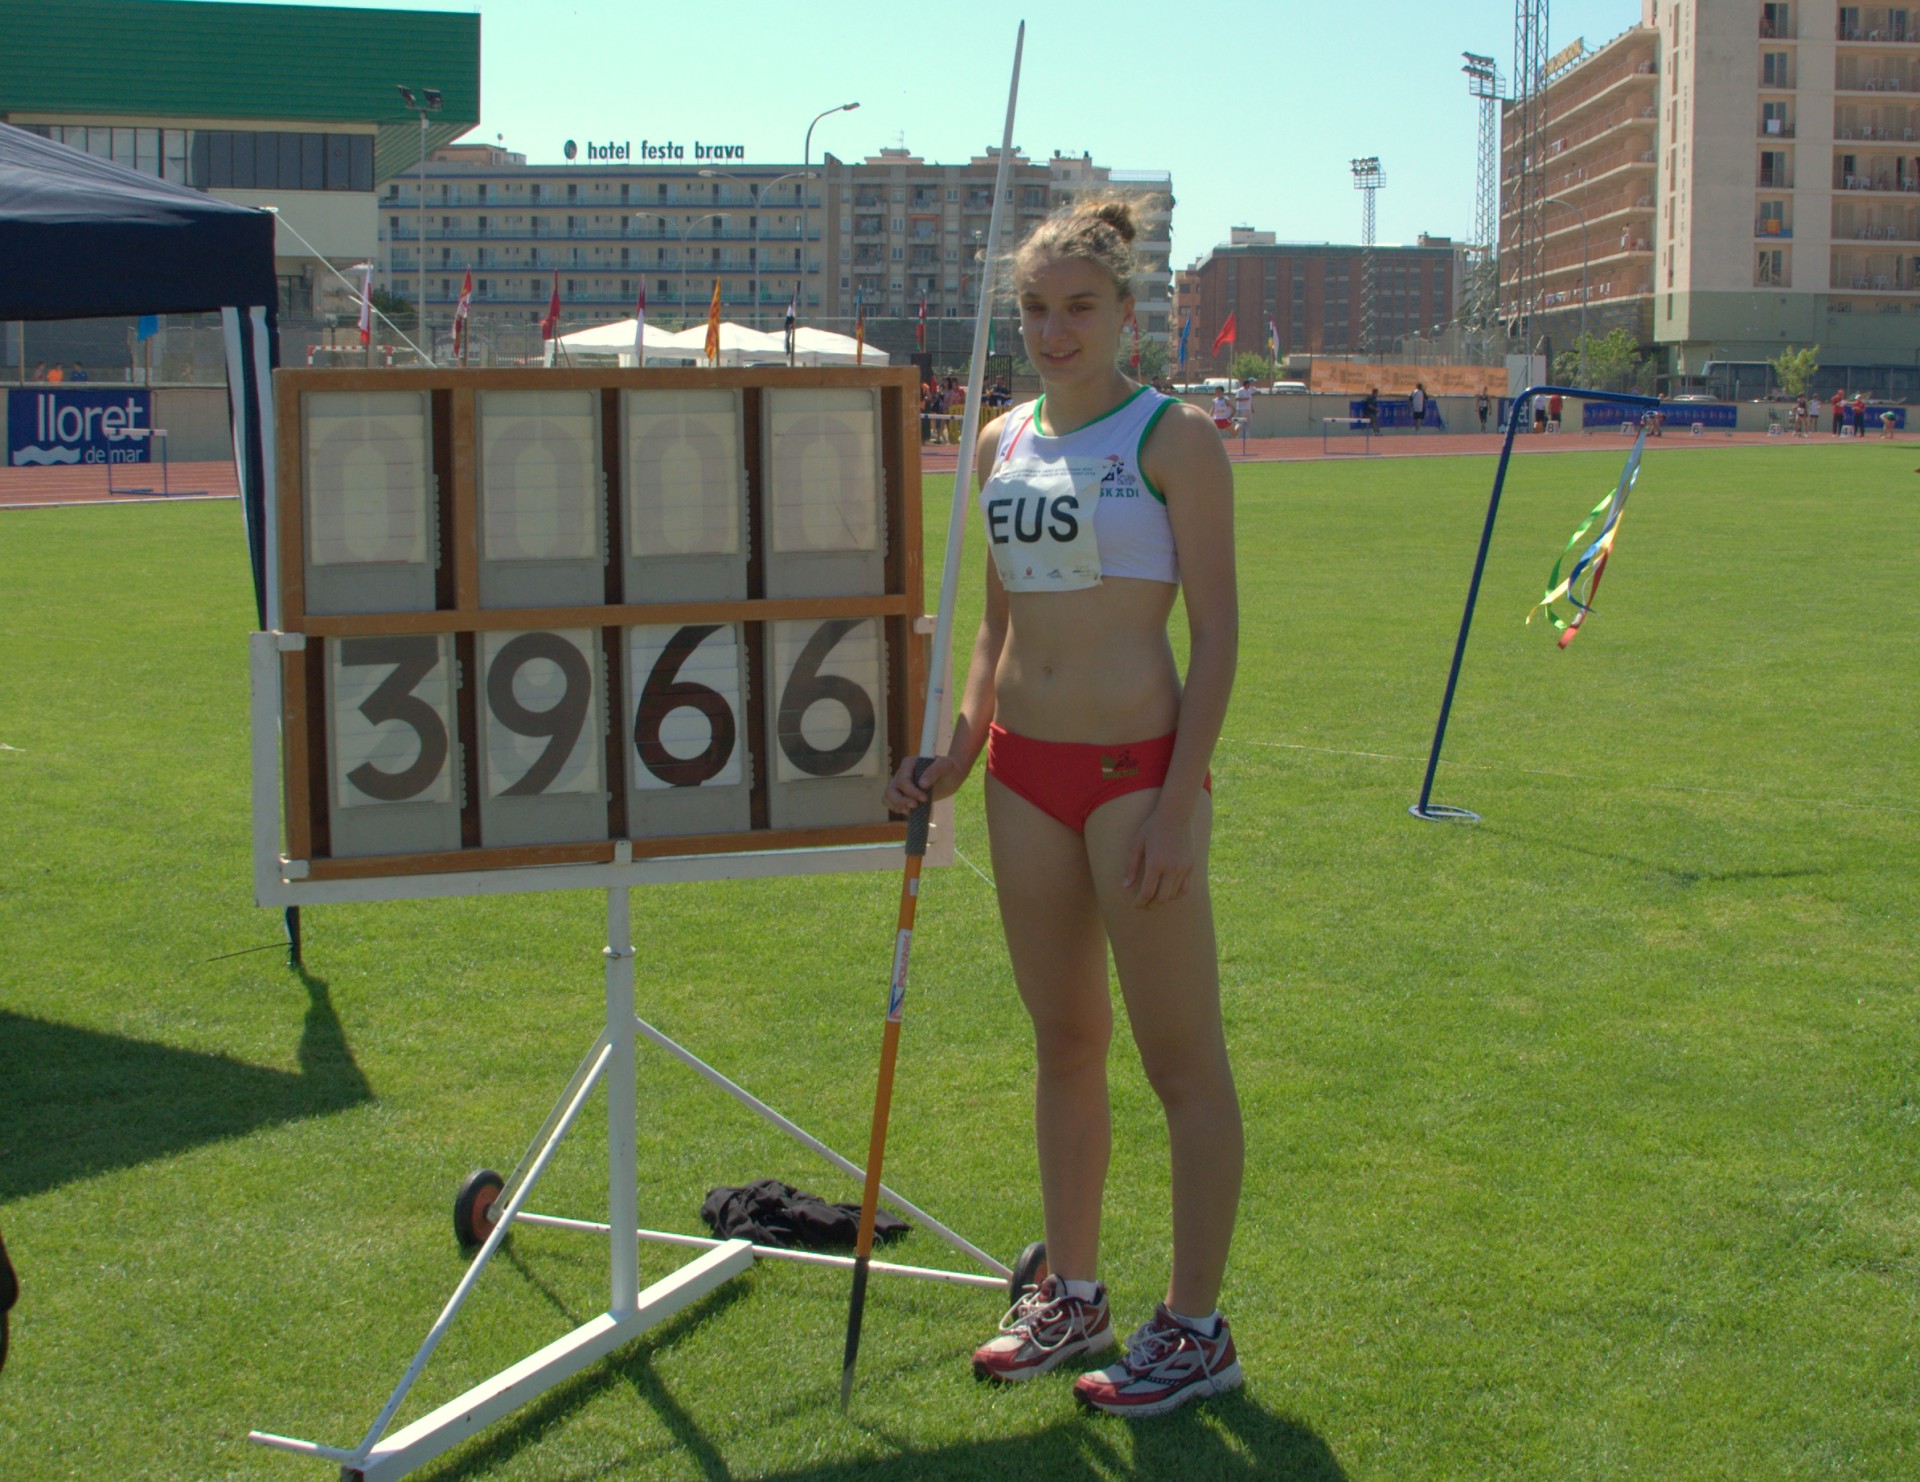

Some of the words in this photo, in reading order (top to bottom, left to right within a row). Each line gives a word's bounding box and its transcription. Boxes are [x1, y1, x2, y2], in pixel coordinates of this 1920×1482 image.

[587, 141, 630, 160] hotel
[641, 139, 684, 160] festa
[695, 140, 745, 160] brava
[38, 393, 144, 443] lloret
[85, 446, 106, 464] de
[110, 447, 144, 464] mar
[988, 495, 1079, 544] EUS
